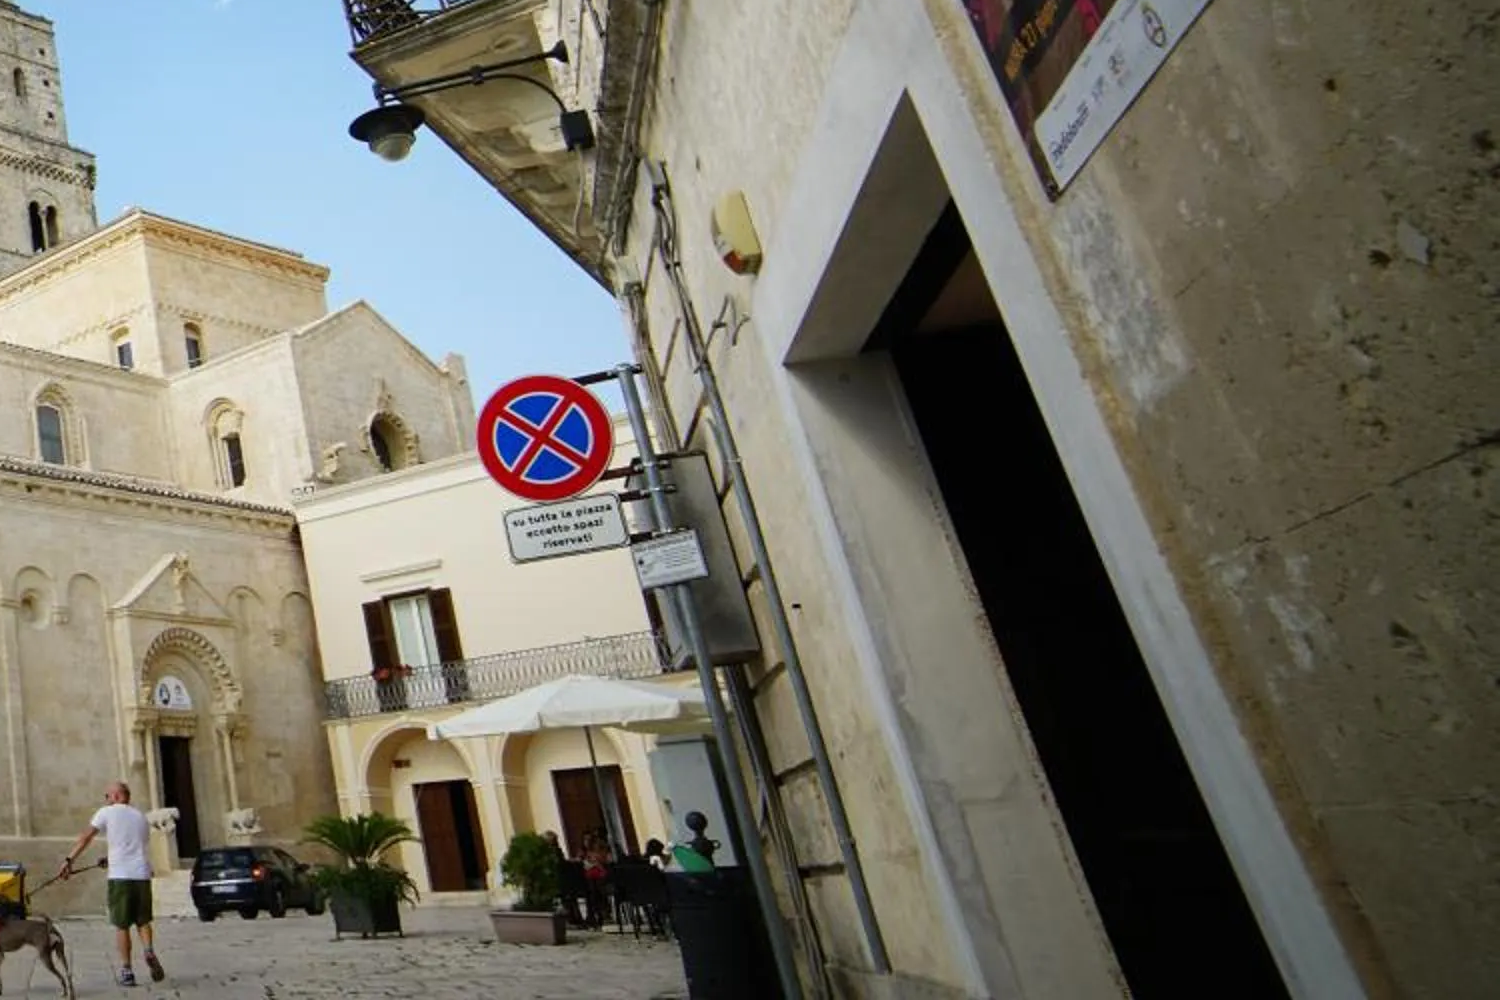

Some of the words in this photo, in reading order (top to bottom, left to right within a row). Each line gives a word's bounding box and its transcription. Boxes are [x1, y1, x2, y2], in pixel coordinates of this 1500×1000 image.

[513, 519, 525, 527] su
[528, 512, 557, 525] tutta
[561, 509, 572, 519] la
[576, 504, 612, 517] piazza
[526, 524, 571, 538] eccetto
[573, 517, 603, 530] spazi
[543, 533, 593, 549] riservati
